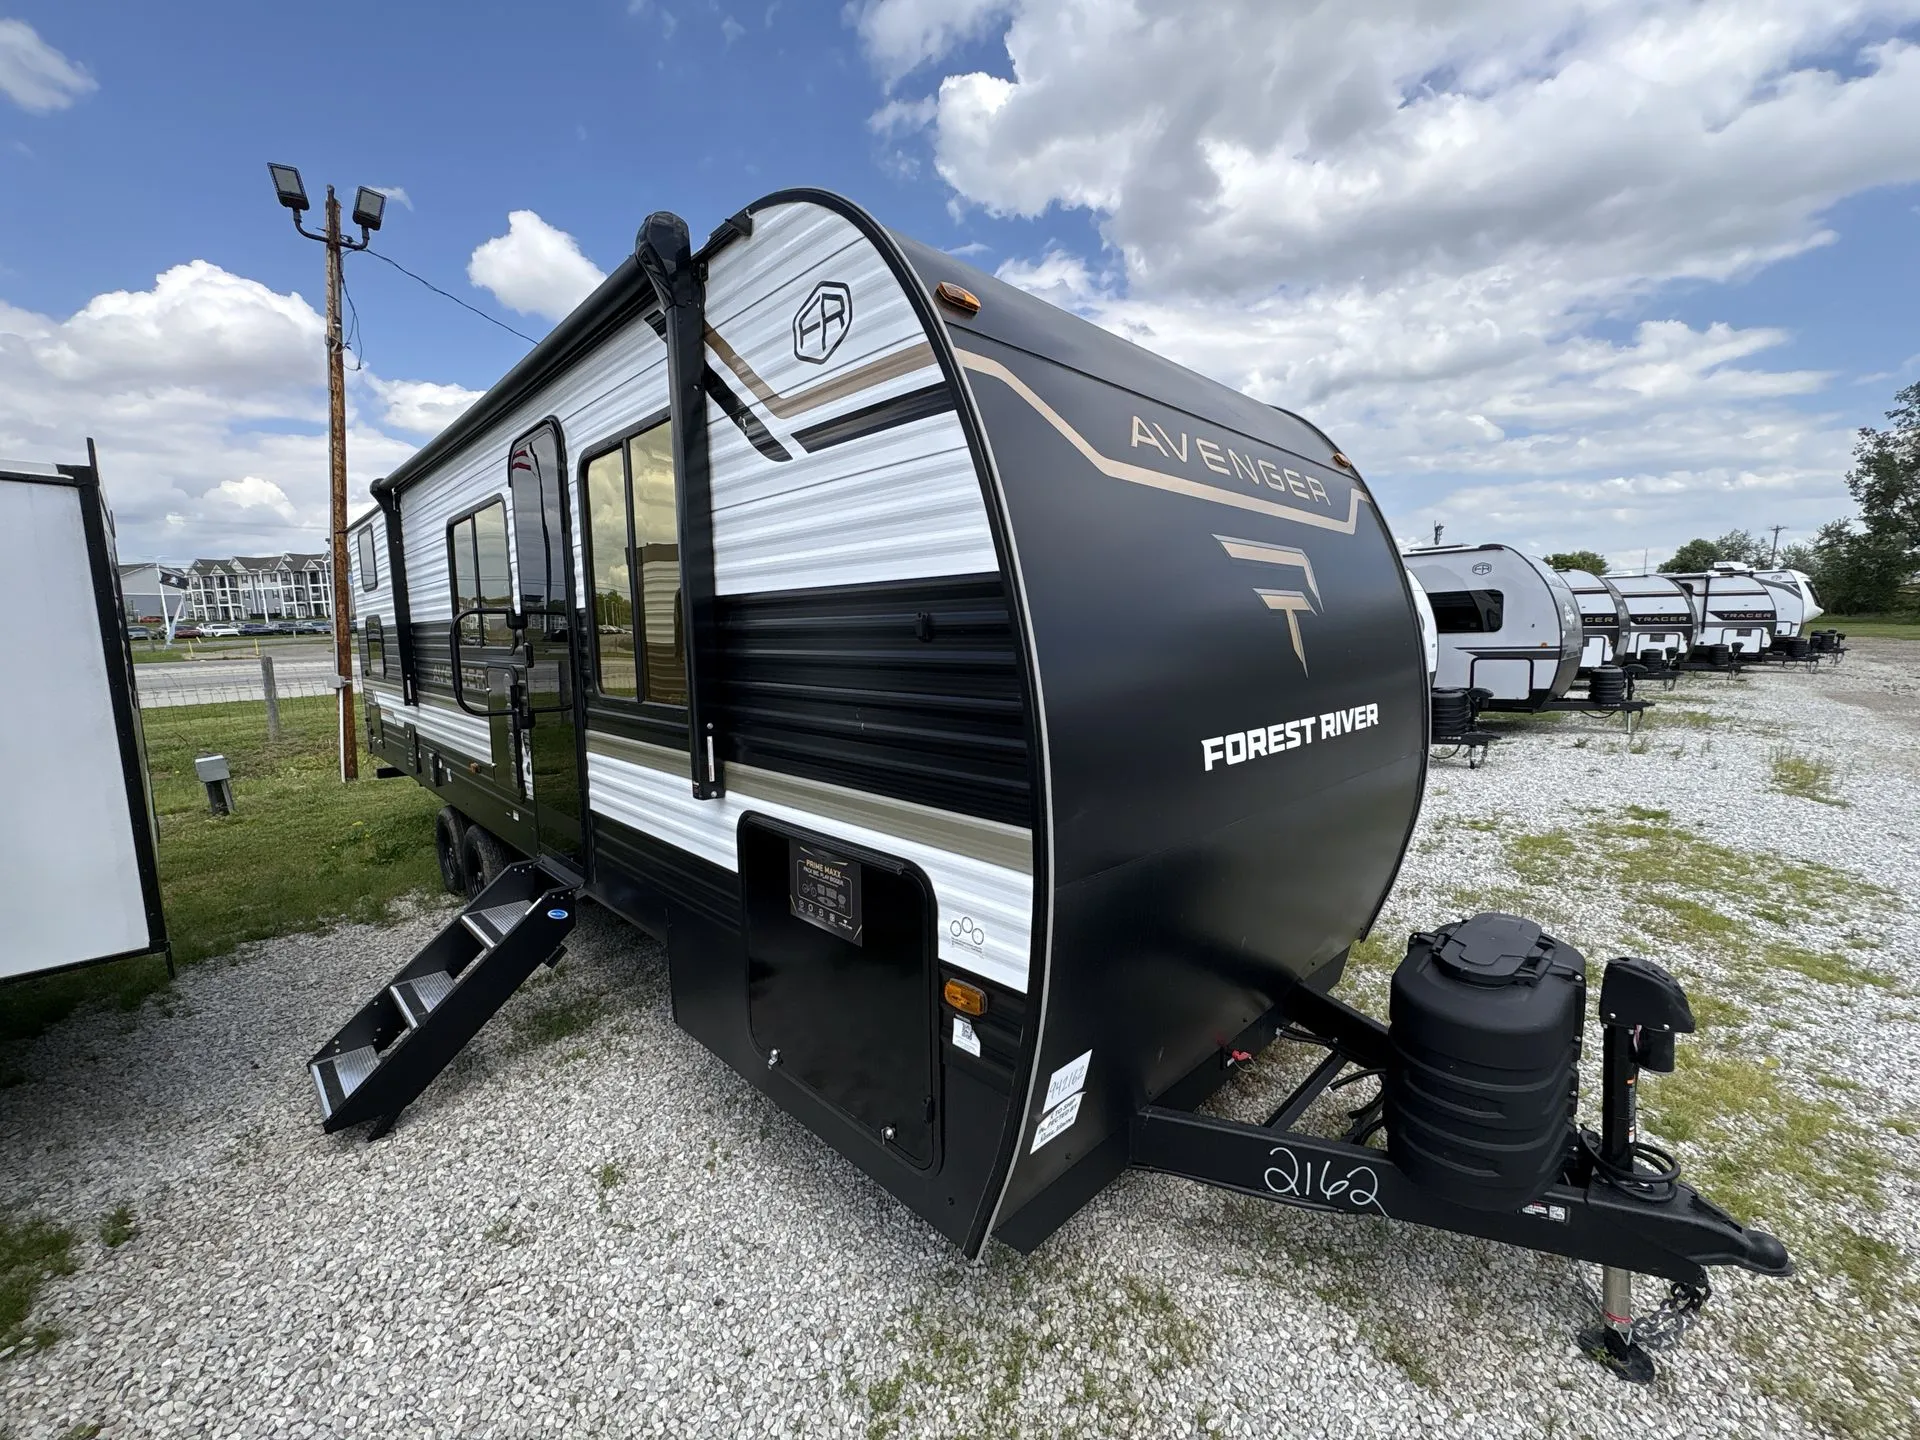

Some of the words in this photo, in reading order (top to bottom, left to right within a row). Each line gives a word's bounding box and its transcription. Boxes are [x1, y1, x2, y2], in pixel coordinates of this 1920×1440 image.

[1130, 415, 1332, 506] AVENGER
[1201, 717, 1316, 772] FOREST
[1319, 703, 1379, 740] RIVER
[805, 859, 824, 872] PRIME
[1264, 1147, 1390, 1218] 2162
